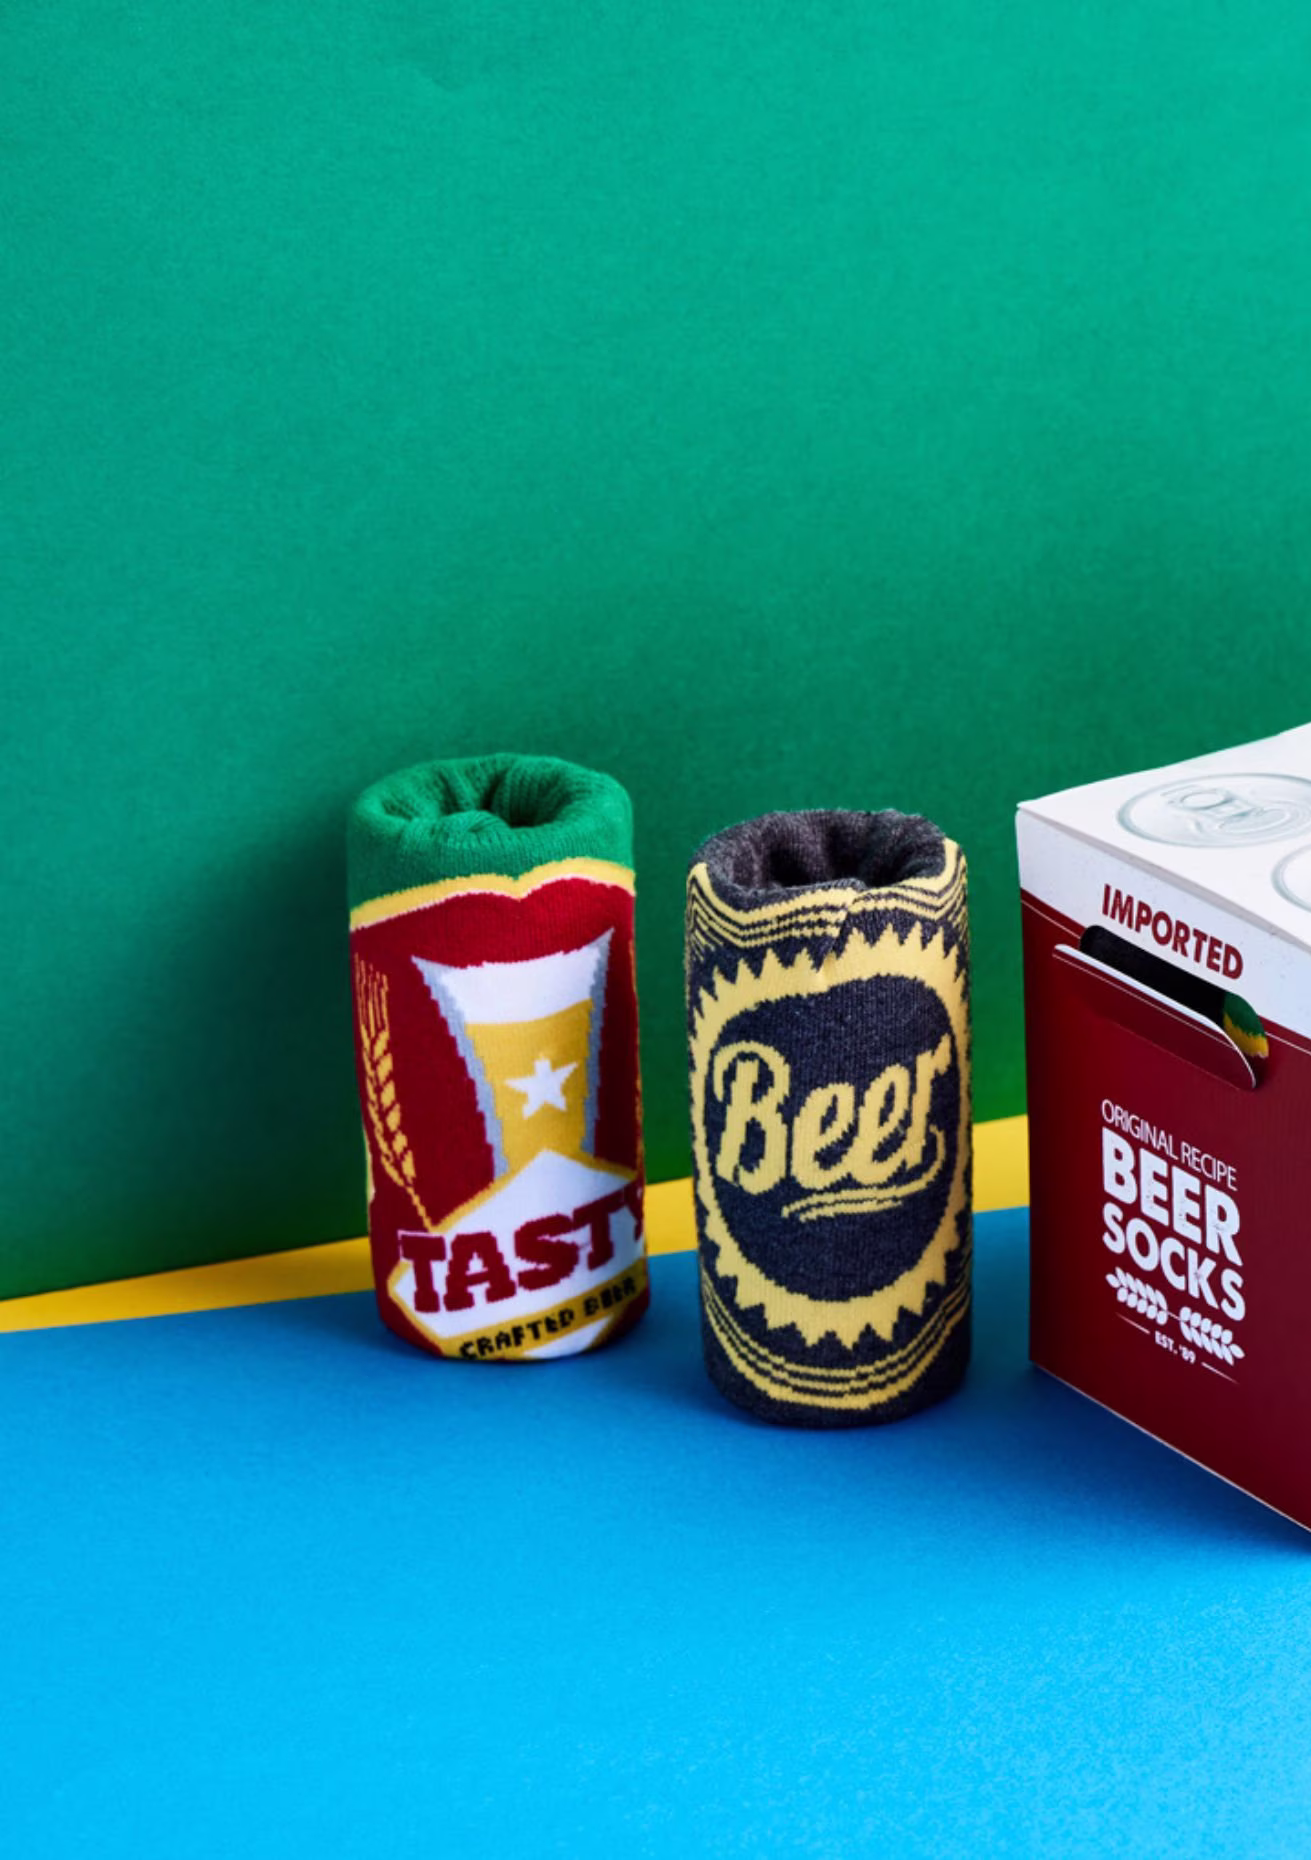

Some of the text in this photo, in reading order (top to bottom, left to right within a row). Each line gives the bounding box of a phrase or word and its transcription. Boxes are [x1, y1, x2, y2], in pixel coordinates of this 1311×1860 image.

[1102, 883, 1243, 979] IMPORTED
[712, 1034, 950, 1197] Beer
[1102, 1099, 1238, 1191] ORIGINAL RECIPE
[1102, 1126, 1243, 1267] BEER
[1102, 1202, 1246, 1321] SOCKS
[459, 1276, 636, 1360] CRAFTED BEER
[1154, 1330, 1178, 1355] EST.
